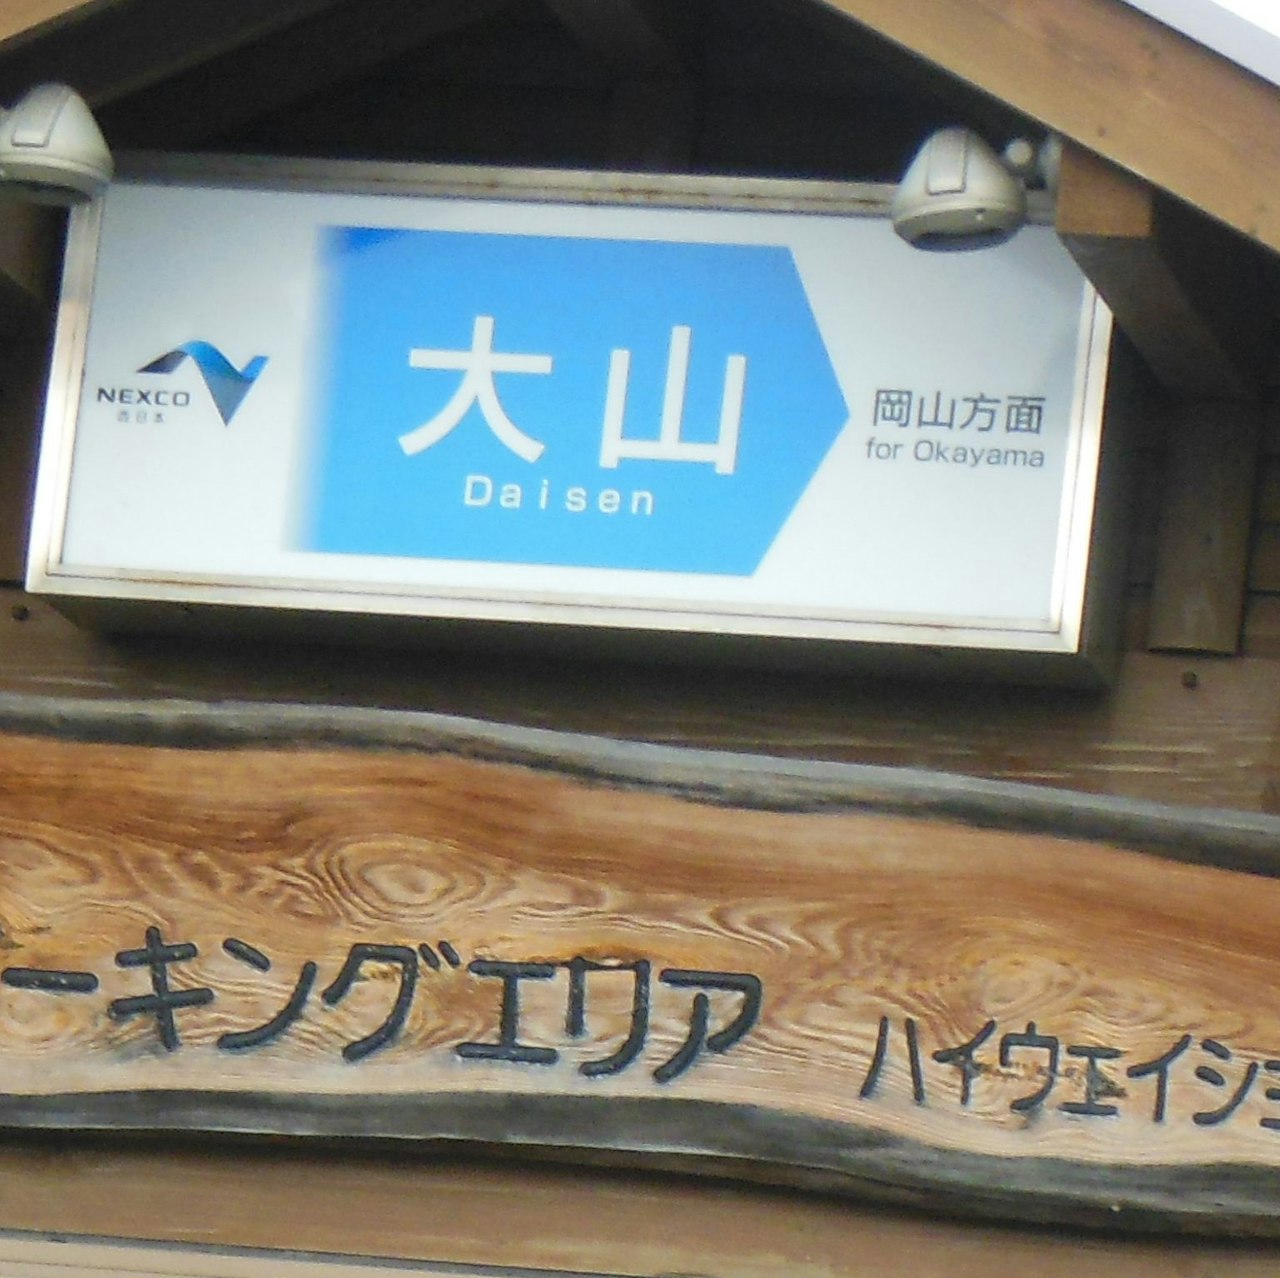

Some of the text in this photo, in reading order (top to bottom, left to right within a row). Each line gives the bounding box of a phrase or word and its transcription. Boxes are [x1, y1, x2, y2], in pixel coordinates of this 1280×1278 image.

[97, 387, 191, 407] NEXCO
[397, 314, 747, 476] 大山
[873, 388, 1047, 434] 岡山方面
[866, 437, 1046, 468] for Okayama
[463, 472, 656, 516] Daisen
